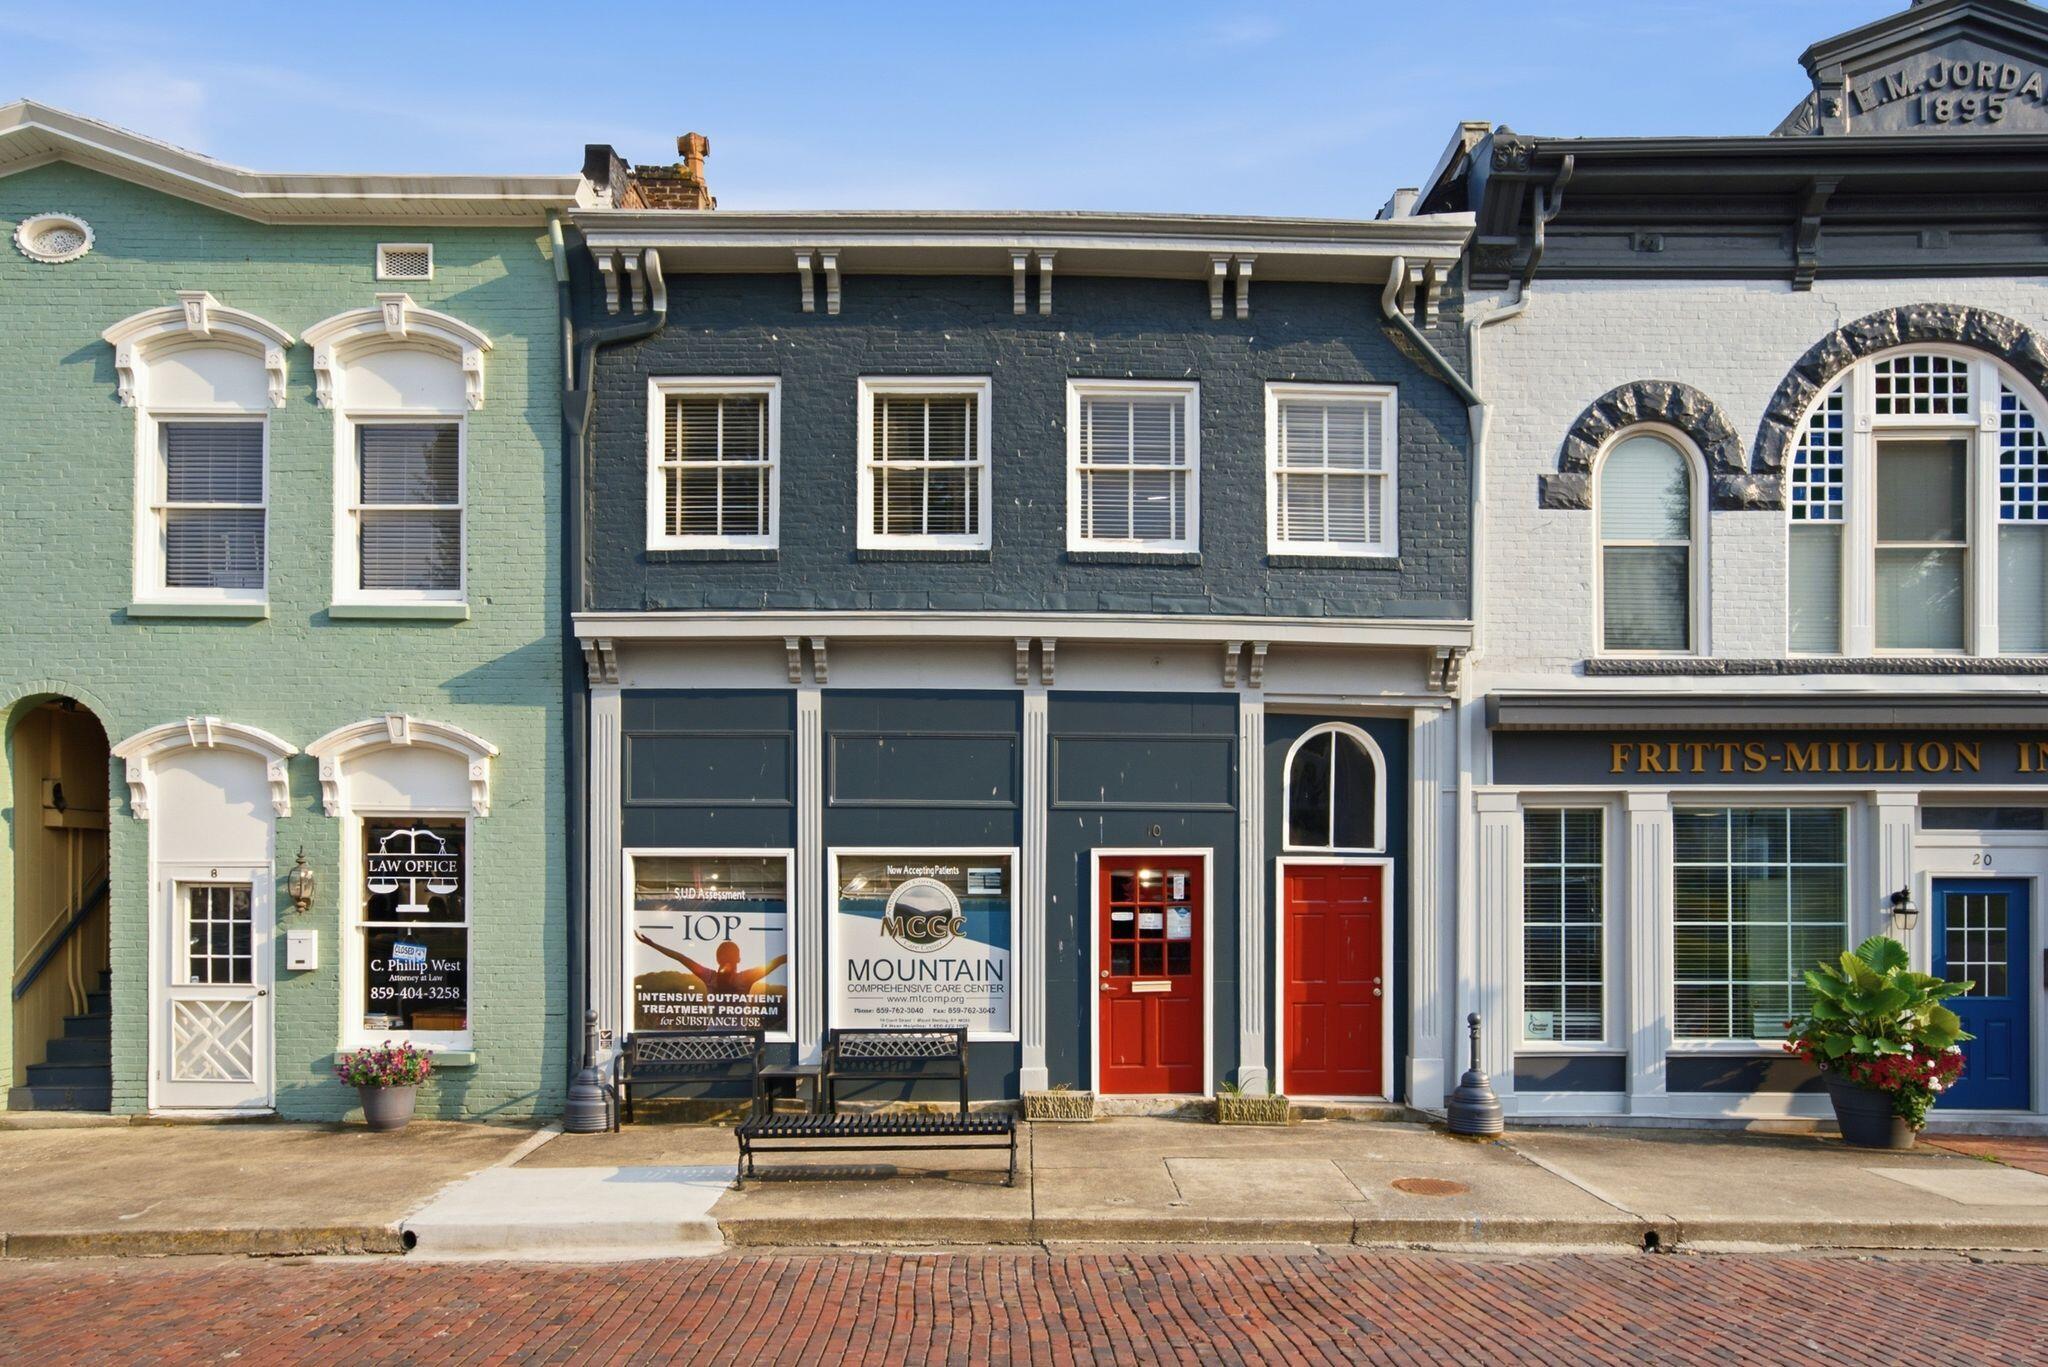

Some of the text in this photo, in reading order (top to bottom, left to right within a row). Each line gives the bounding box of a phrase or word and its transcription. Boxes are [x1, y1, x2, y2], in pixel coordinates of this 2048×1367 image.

[1920, 94, 2008, 122] 1895
[1609, 741, 1984, 773] FRITTS-MILLION
[1972, 853, 1992, 866] 20
[368, 860, 458, 873] LAW OFFICE
[887, 865, 902, 874] Now
[903, 865, 934, 877] Accepting
[211, 868, 218, 878] 8
[682, 915, 742, 941] IOP
[394, 945, 415, 955] CLOSED
[370, 959, 461, 974] C. Phillip West
[848, 959, 1004, 982] MOUNTAIN
[388, 974, 419, 983] Attorney
[370, 986, 460, 999] 859-404-3258
[847, 984, 1004, 993] COMPREHENSIVE CARE CENTER
[638, 992, 783, 1003] INTENSIVE OUTPATIENT
[886, 994, 965, 1004] www.mtcomp.org
[642, 1004, 778, 1015] TREATMENT PROGRAM
[660, 1016, 761, 1027] for SUBSTANCE USE
